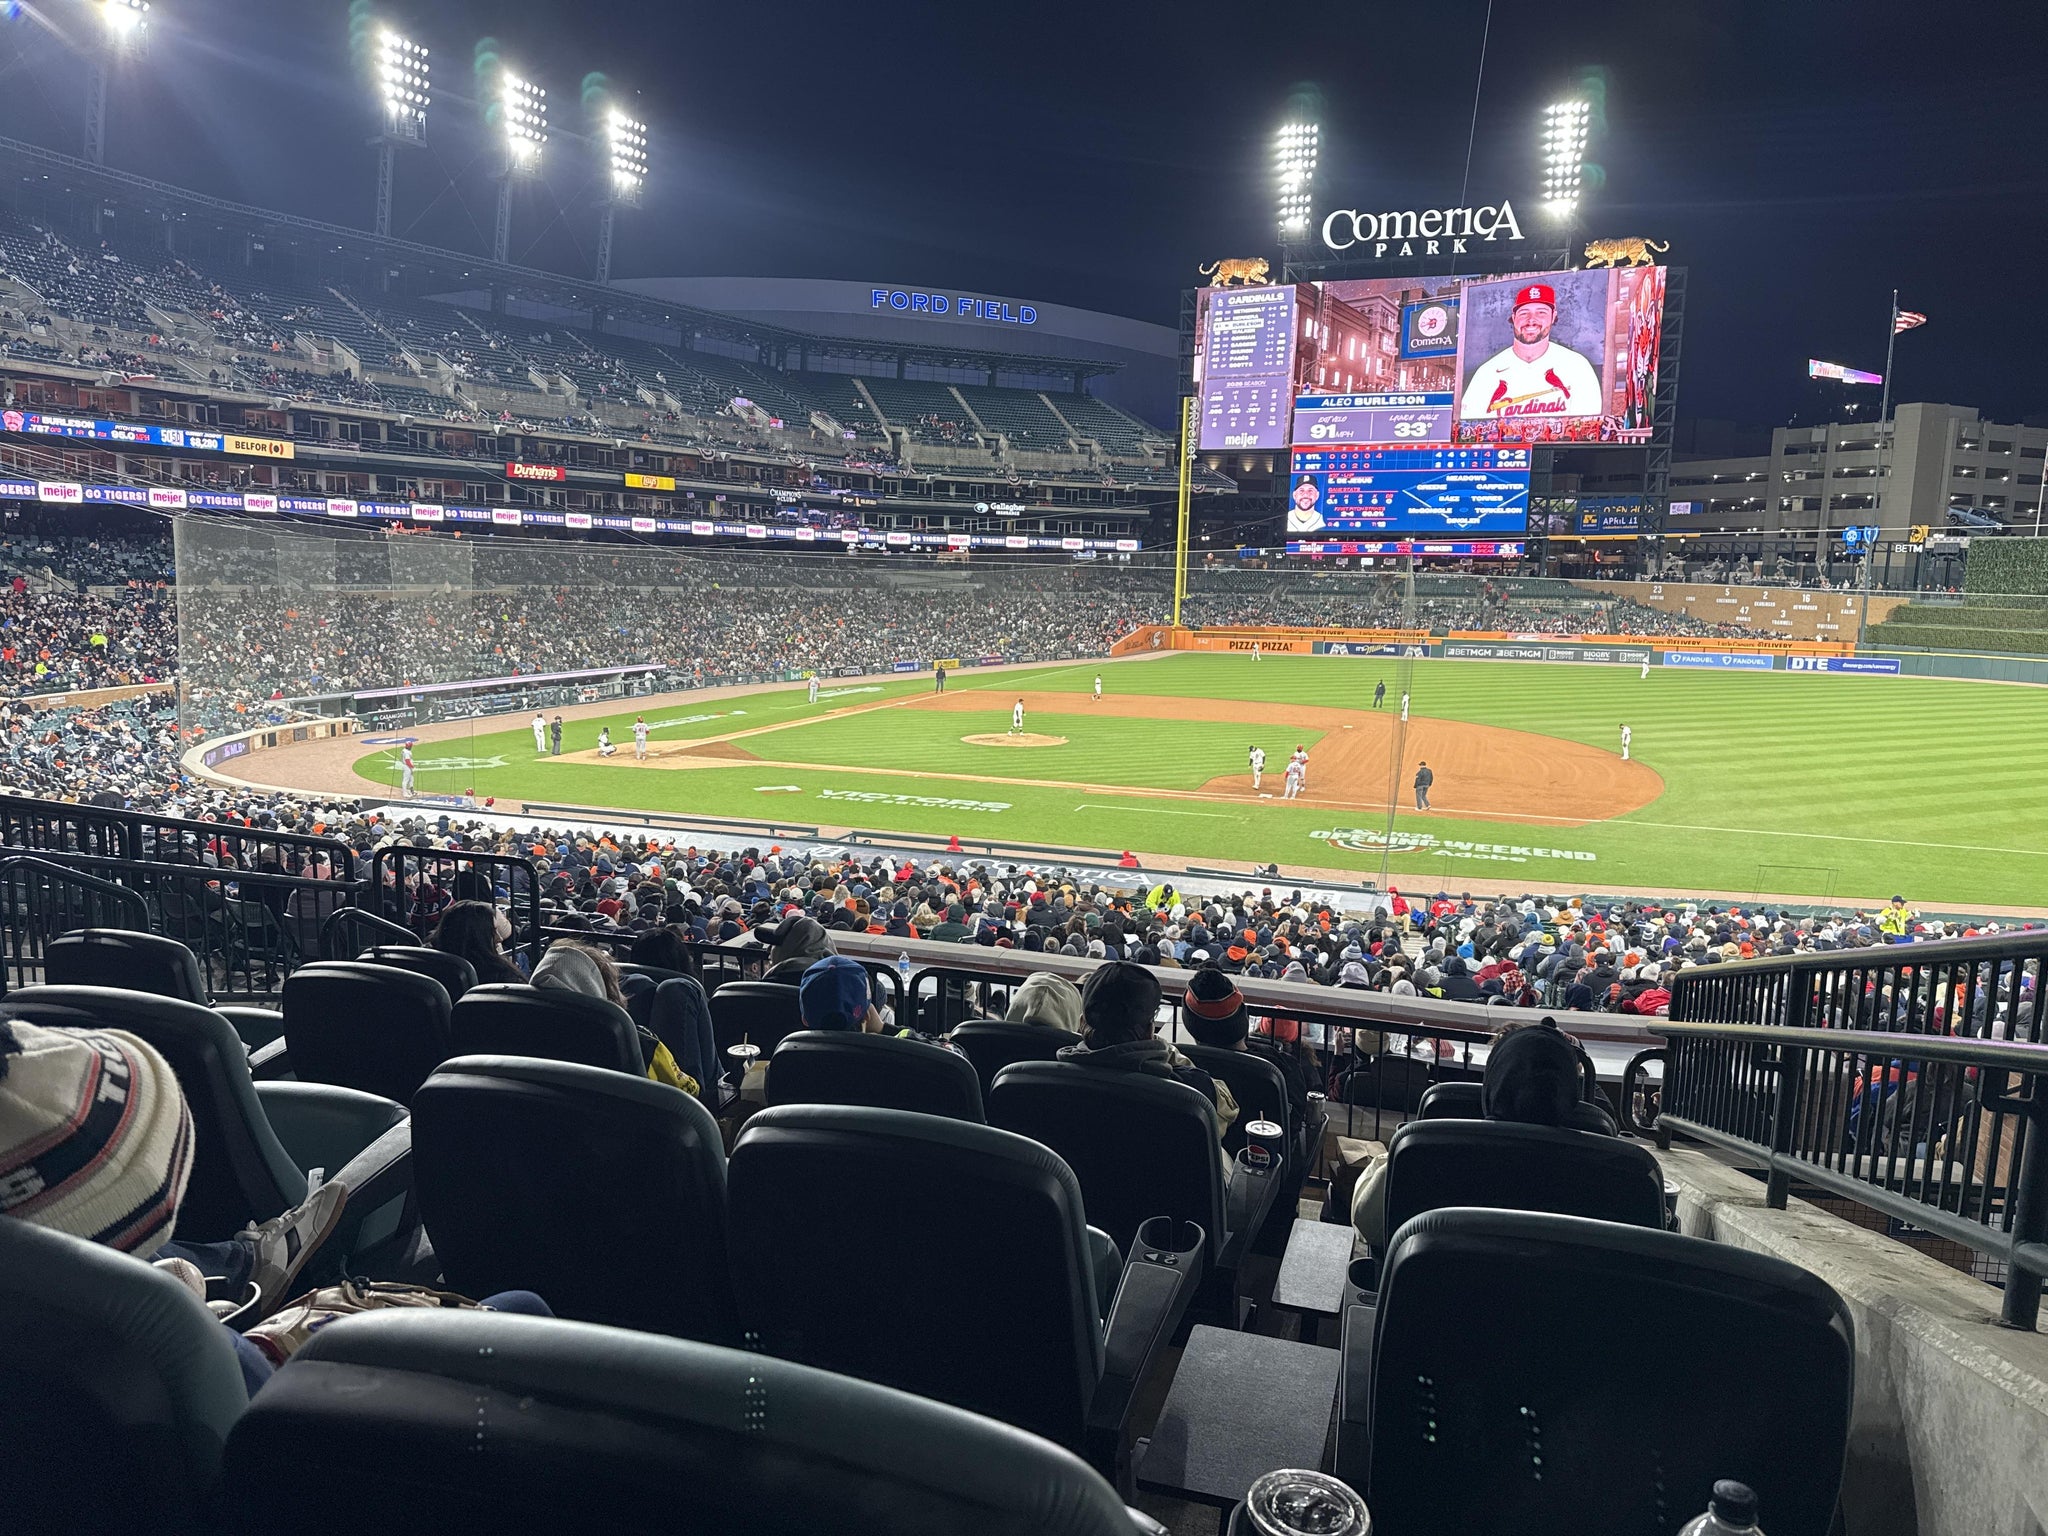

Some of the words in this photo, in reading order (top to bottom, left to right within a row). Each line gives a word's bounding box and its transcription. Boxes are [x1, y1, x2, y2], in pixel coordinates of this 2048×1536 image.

[1374, 237, 1468, 259] PARK
[1228, 292, 1285, 305] CARDINALS
[871, 288, 950, 314] FORD
[957, 297, 1038, 325] FIELD
[1354, 395, 1426, 406] BURLESON
[41, 415, 96, 430] BURLESON
[1186, 411, 1200, 461] Rocket
[1310, 423, 1337, 439] 91
[234, 440, 268, 452] BELFOR
[1224, 432, 1259, 448] meijer
[1498, 449, 1526, 459] 0-2
[513, 463, 558, 478] Dunham's
[0, 484, 36, 496] GERS!
[43, 485, 78, 500] meijer
[85, 488, 101, 499] GO
[104, 489, 147, 502] TIGERS!
[769, 487, 802, 499] CHAMPIONS
[153, 490, 183, 505] meijer
[189, 494, 203, 504] GO
[206, 495, 243, 507] TIGERS!
[247, 496, 274, 510] meijer
[279, 499, 292, 509] GO
[294, 500, 326, 511] TIGERS!
[359, 504, 373, 514] GO
[990, 502, 1026, 512] Gallagher
[1653, 585, 1663, 594] 23
[1724, 587, 1730, 596] 5
[1763, 590, 1769, 600] 2
[1802, 594, 1811, 603] 16
[1846, 597, 1853, 607] 6
[1739, 606, 1750, 615] 47
[1780, 609, 1786, 618] 3
[1826, 612, 1831, 622] 1
[1261, 642, 1293, 651] PIZZA!
[1454, 648, 1492, 657] BETMGM
[1503, 650, 1541, 658] BETMGM
[1681, 655, 1714, 663] FANDUEL
[1732, 657, 1766, 665] FANDUEL
[1791, 657, 1829, 671] DTE
[822, 789, 1013, 810] VICTORS
[1308, 830, 1441, 847] OPENING
[1443, 840, 1597, 861] WEEKEND
[1431, 849, 1528, 863] Adobe
